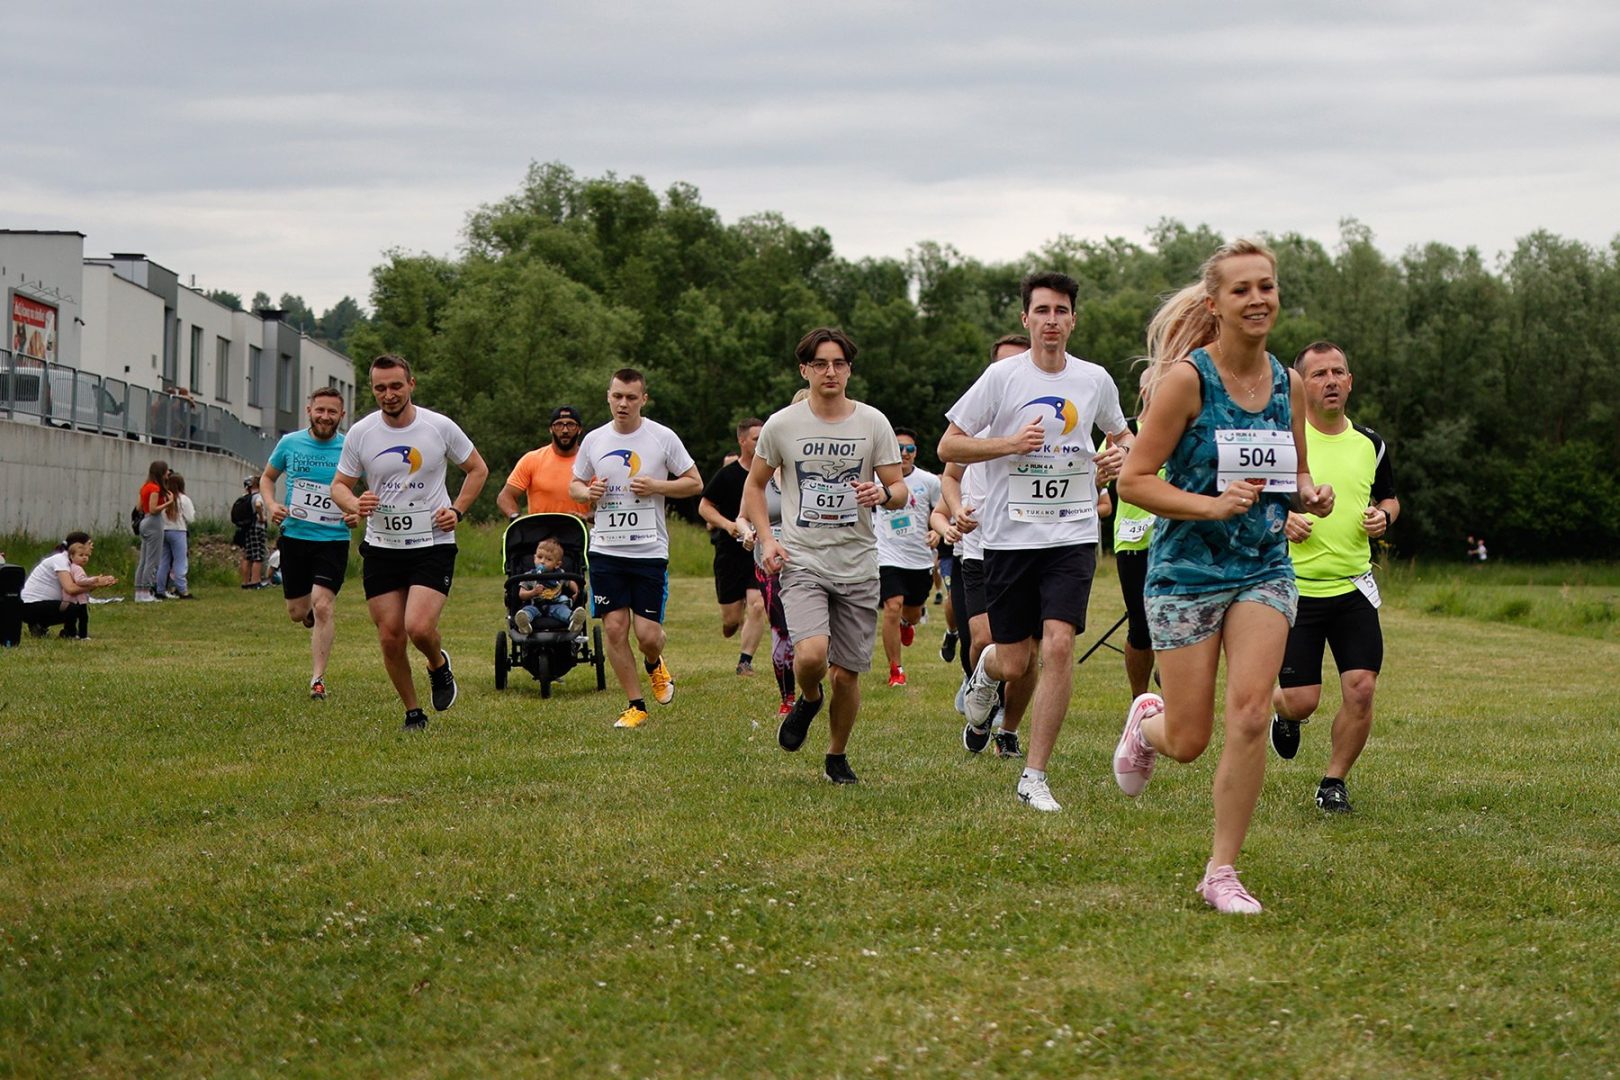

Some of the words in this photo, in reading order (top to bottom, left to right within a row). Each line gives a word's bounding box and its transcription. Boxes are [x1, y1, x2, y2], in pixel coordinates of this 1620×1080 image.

[803, 442, 824, 456] OH
[828, 443, 856, 456] NO!
[1034, 444, 1080, 453] KANO
[1239, 447, 1277, 467] 504
[1032, 479, 1069, 498] 167
[304, 493, 331, 509] 126
[816, 494, 845, 508] 617
[384, 516, 412, 530] 169
[608, 512, 638, 527] 170
